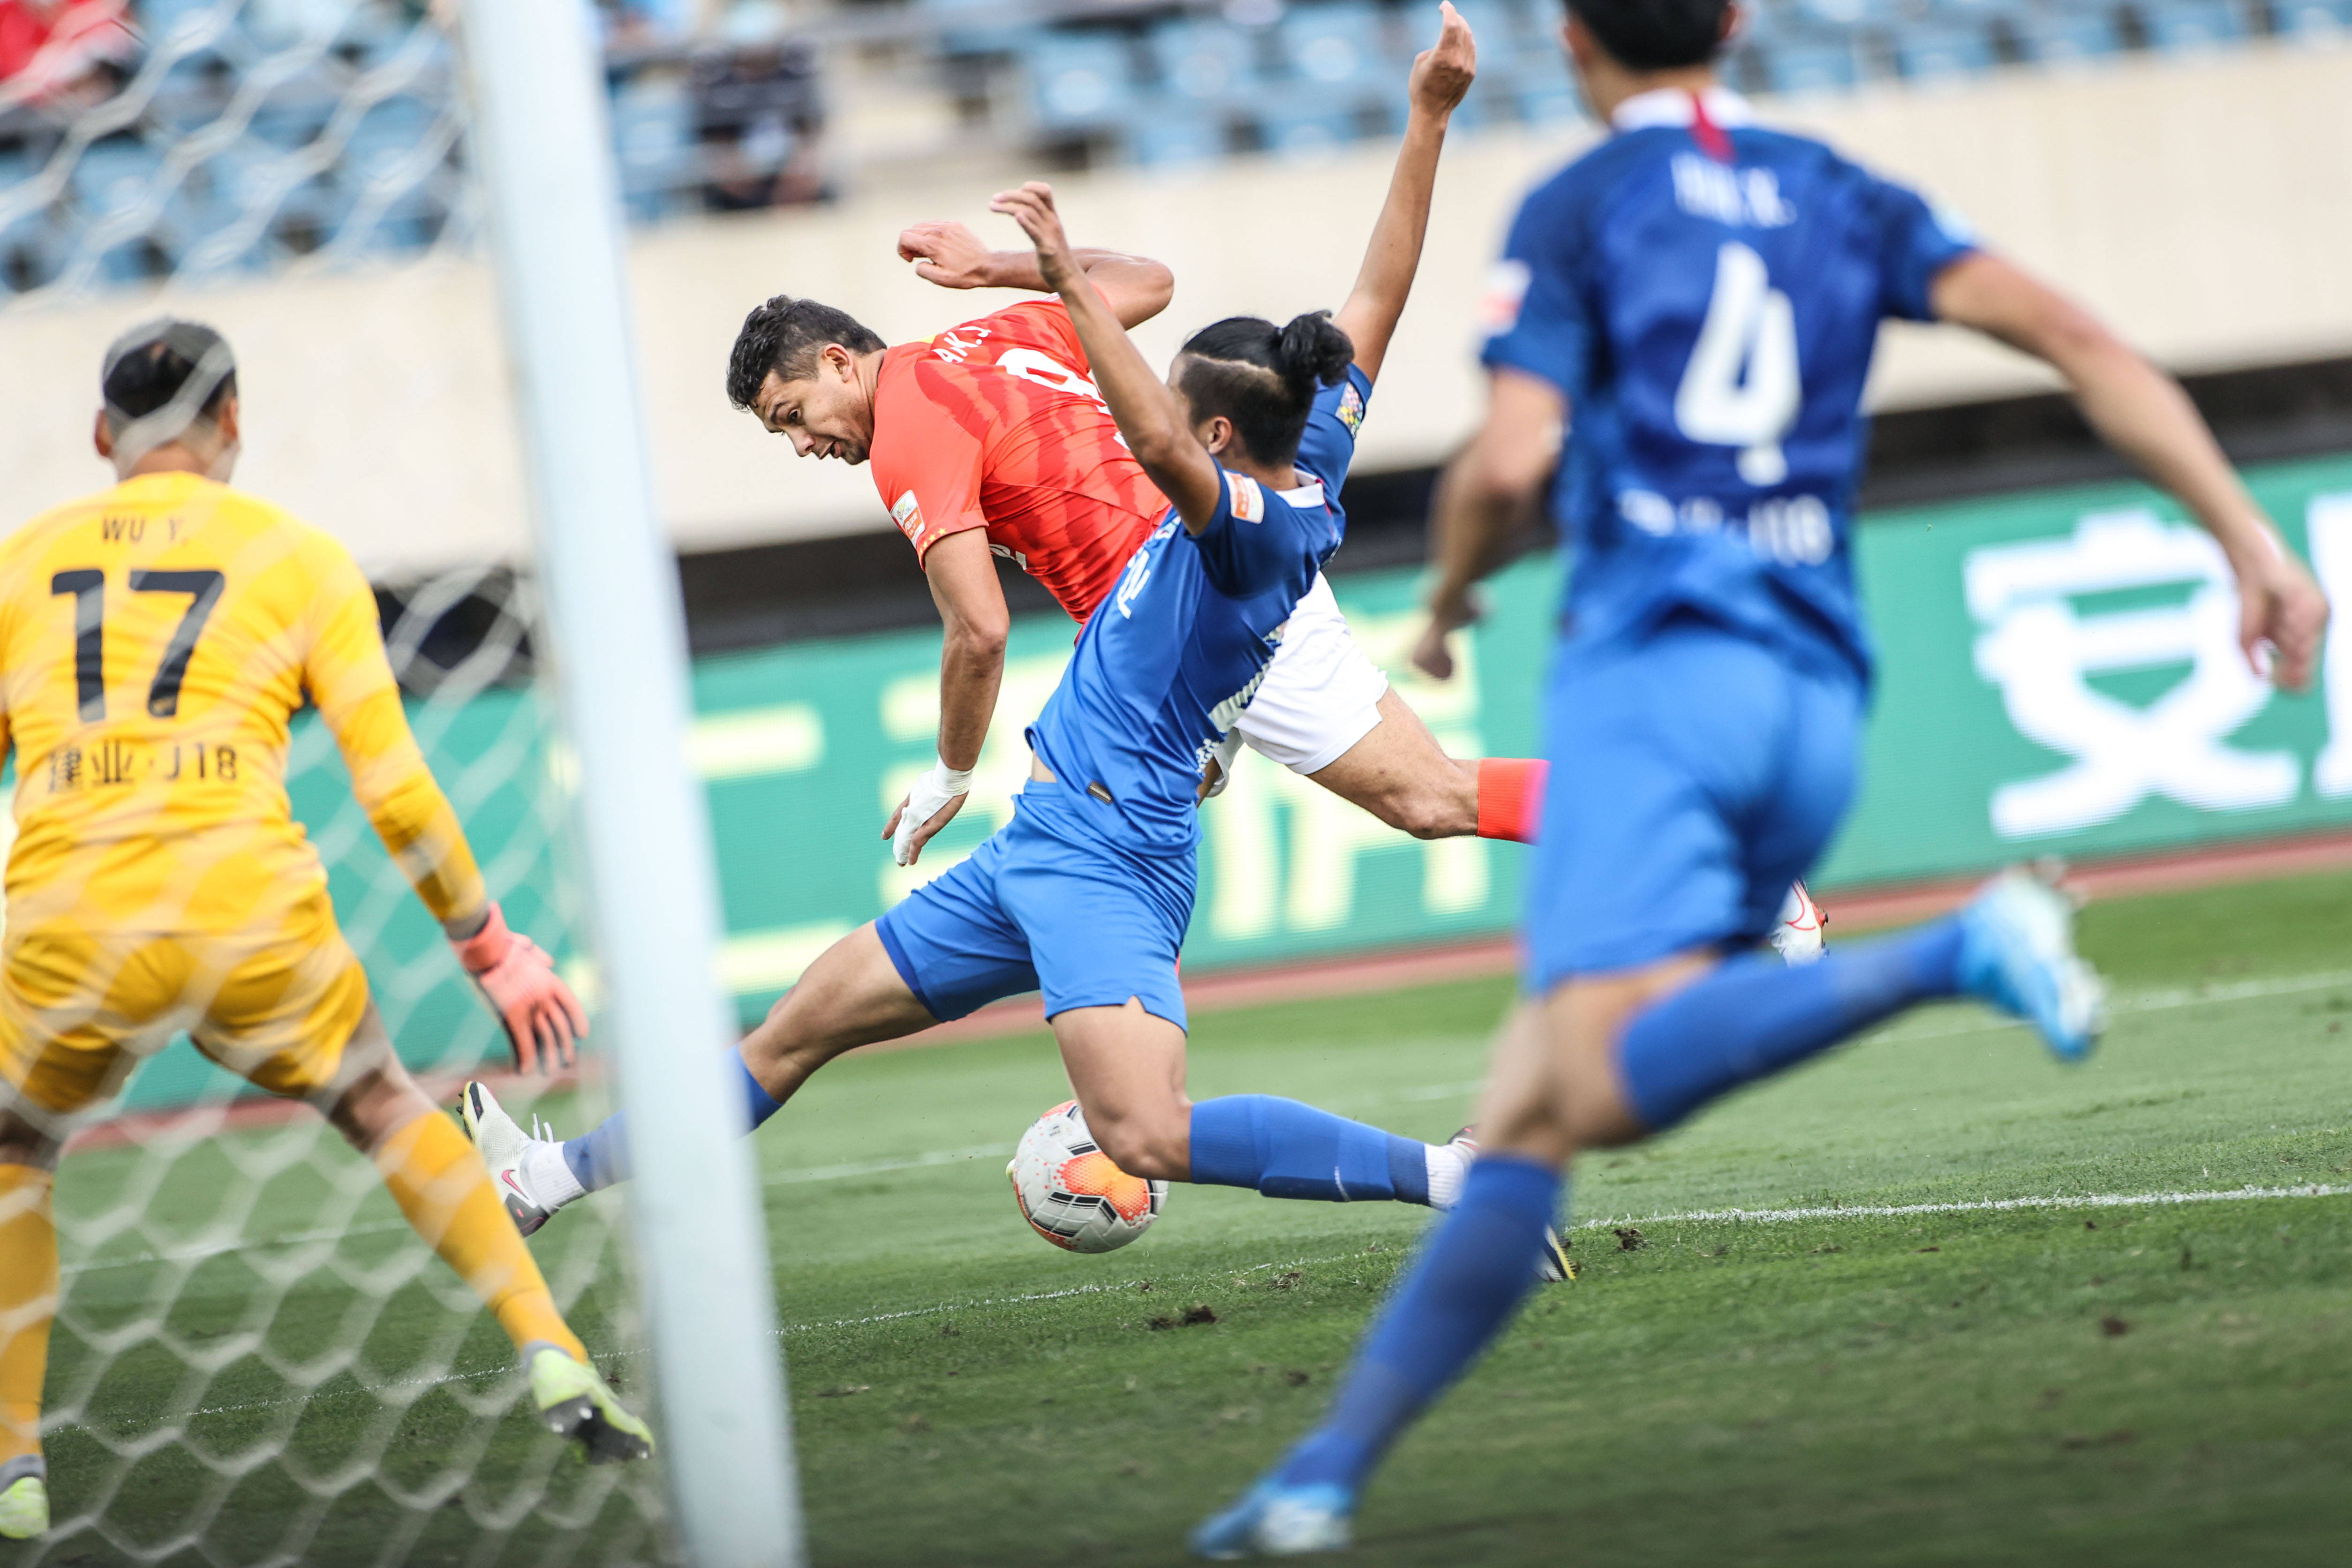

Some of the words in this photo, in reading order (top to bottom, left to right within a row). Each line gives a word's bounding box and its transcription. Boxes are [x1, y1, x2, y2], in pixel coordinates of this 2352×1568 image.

[1673, 239, 1804, 486] 4
[102, 518, 146, 543] WU
[51, 569, 226, 723] 17
[1964, 493, 2352, 842] 安
